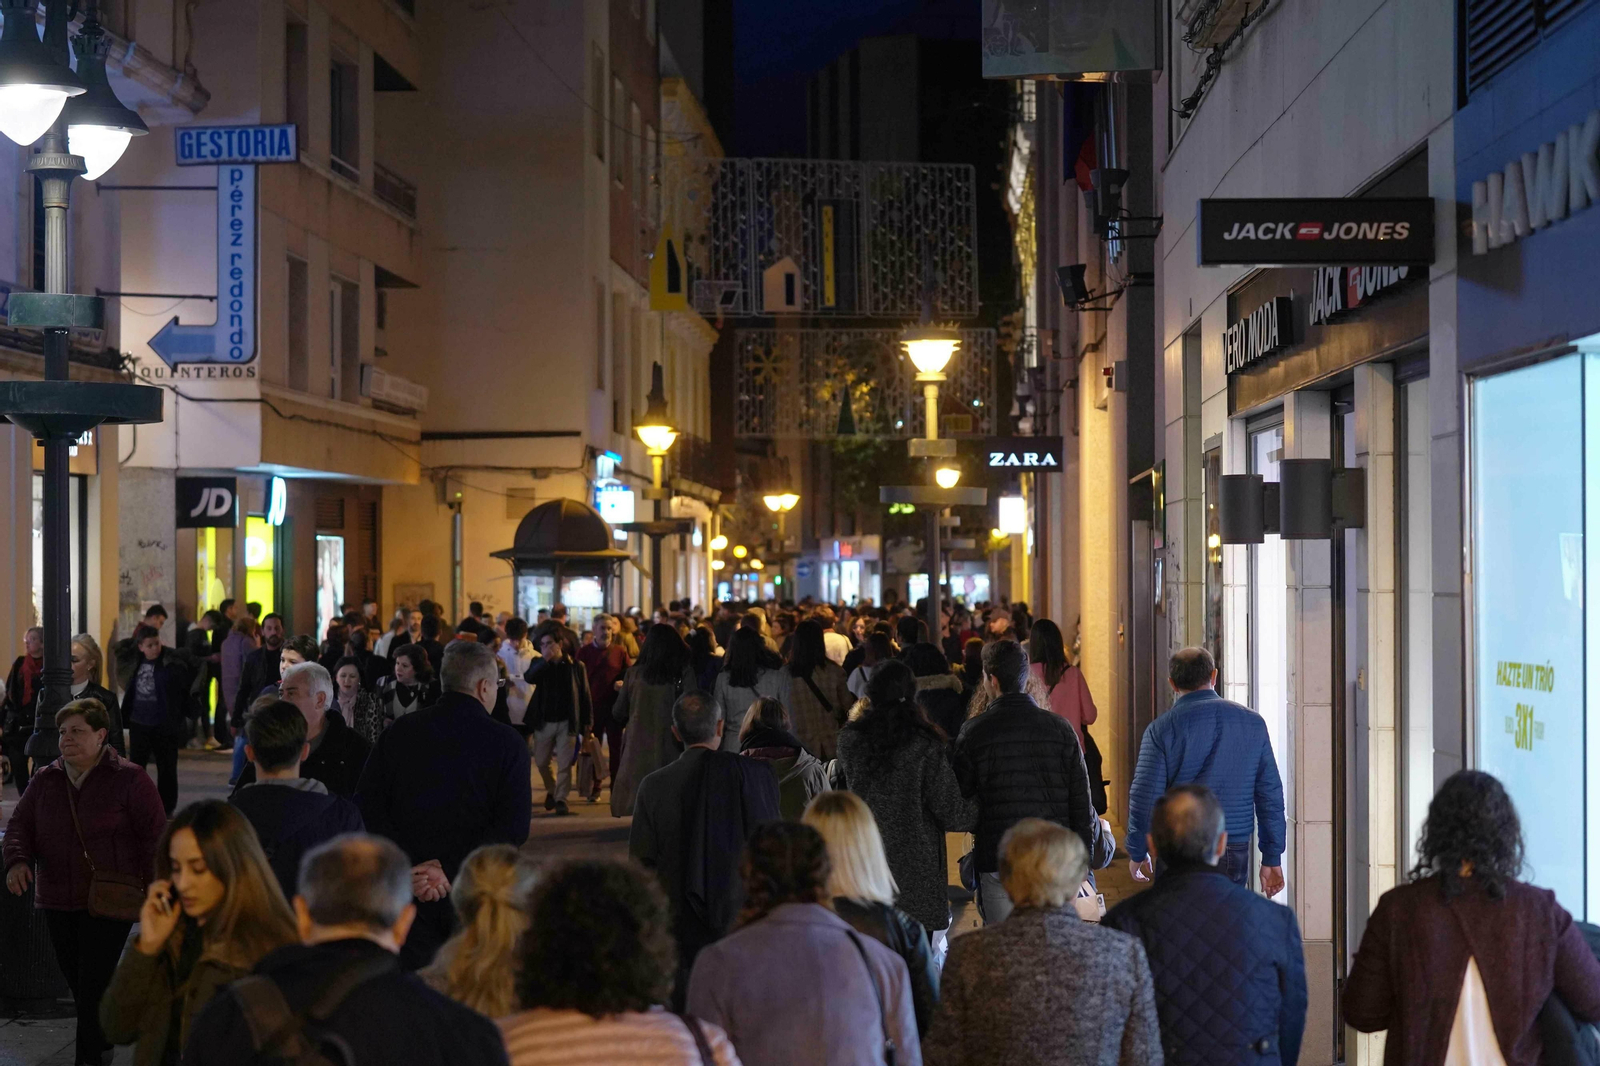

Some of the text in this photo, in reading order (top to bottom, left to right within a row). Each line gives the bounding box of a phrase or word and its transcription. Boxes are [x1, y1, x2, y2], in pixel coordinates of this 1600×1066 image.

[180, 128, 291, 159] GESTORIA
[1223, 222, 1410, 240] JACK JONES
[229, 253, 243, 360] redondo
[1309, 266, 1342, 326] JACK
[1222, 297, 1279, 375] VERO MODA
[989, 452, 1058, 467] ZARA
[190, 487, 233, 518] JD
[1496, 659, 1555, 693] HAZTE UN TRÍO
[1515, 702, 1534, 751] 3X1
